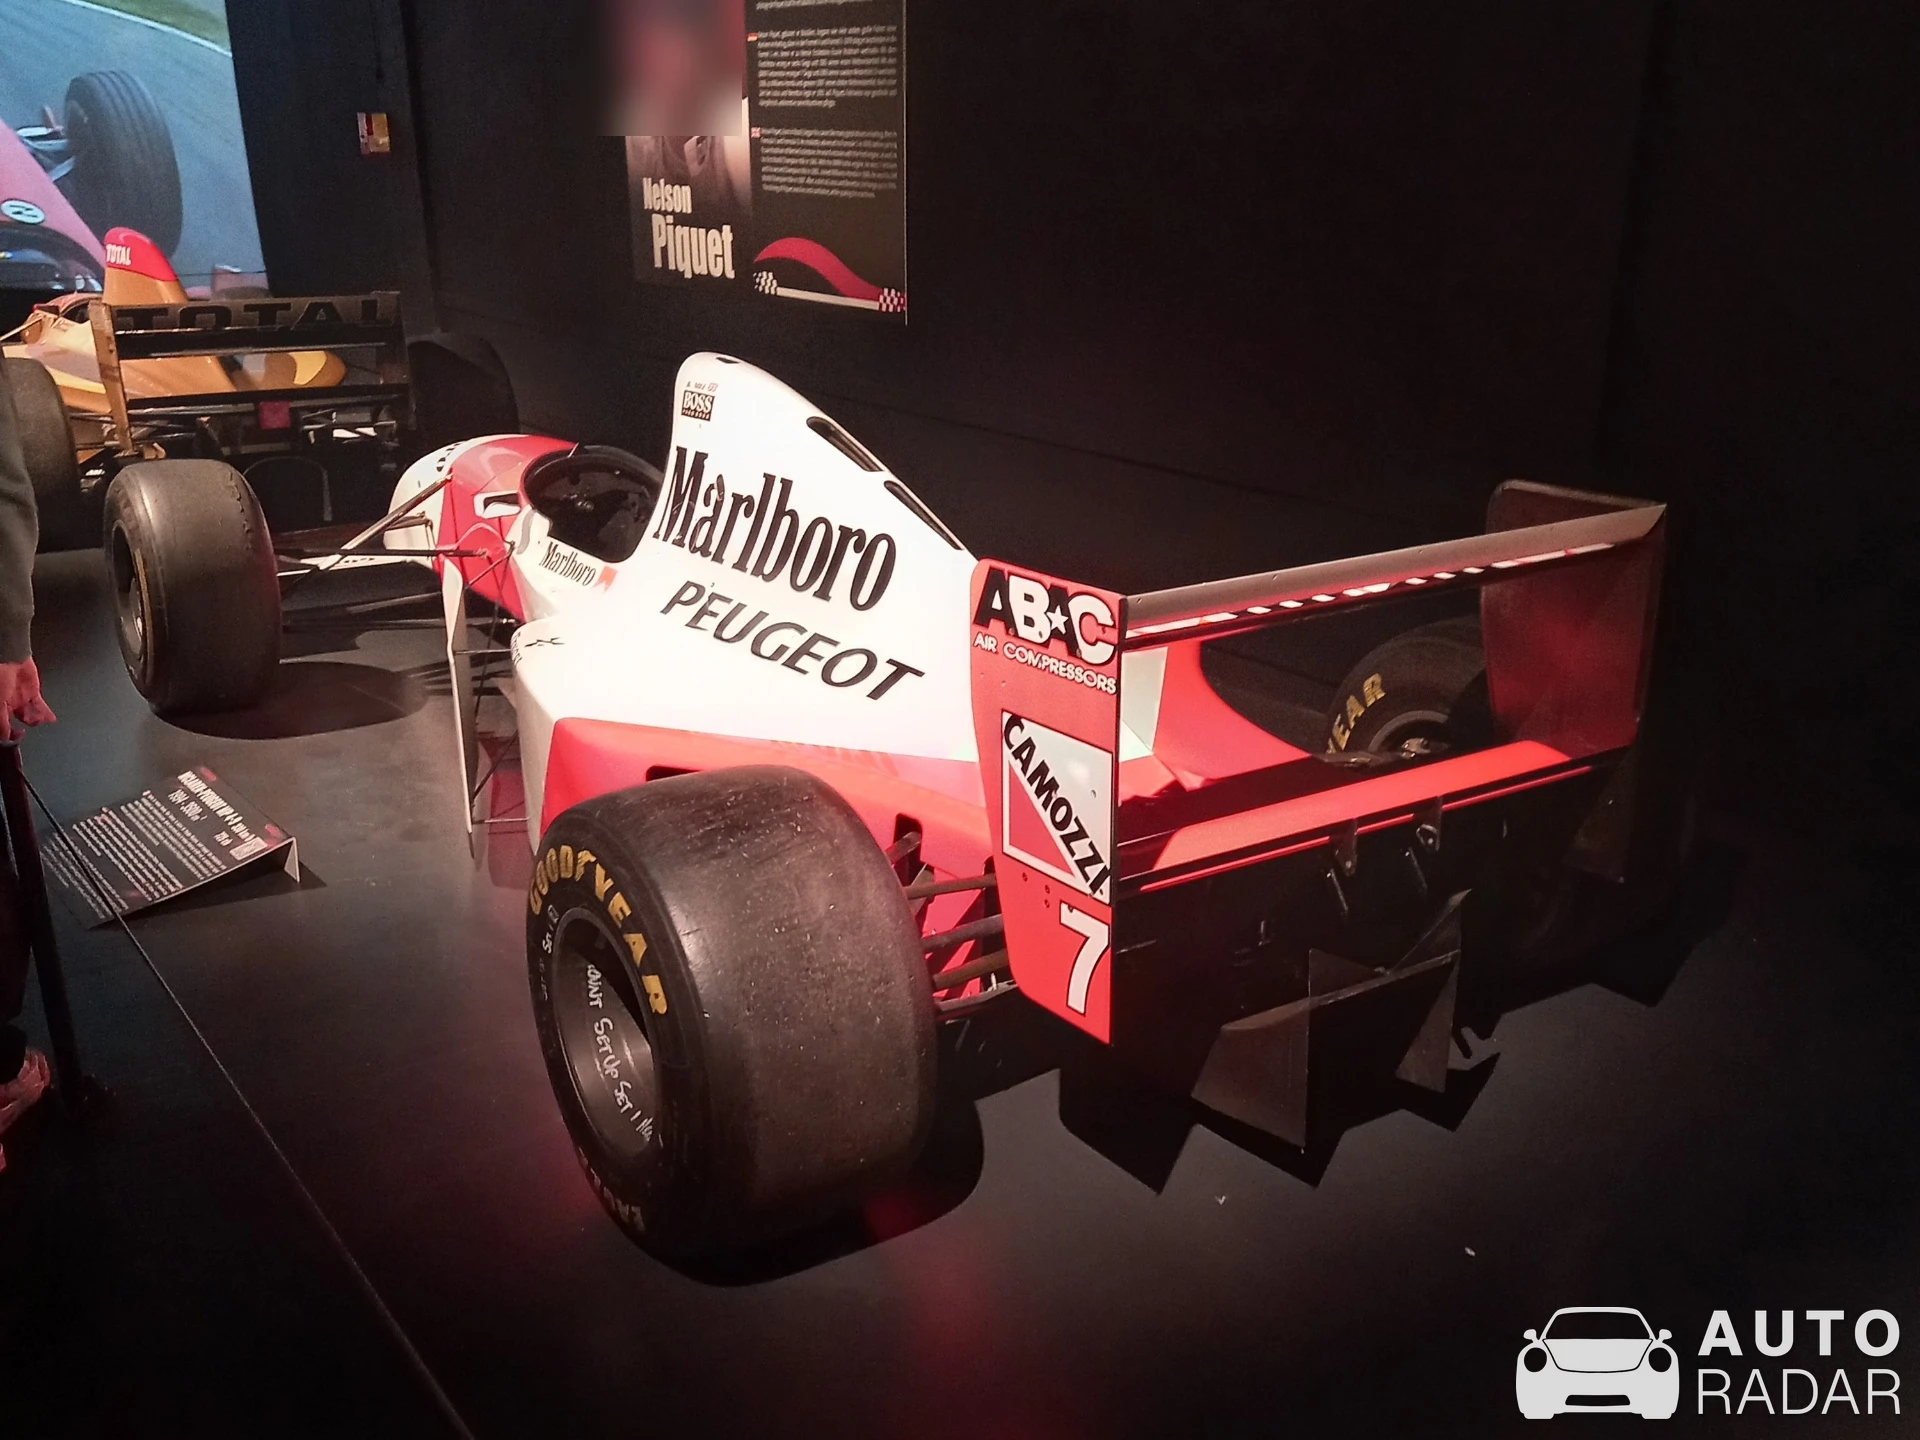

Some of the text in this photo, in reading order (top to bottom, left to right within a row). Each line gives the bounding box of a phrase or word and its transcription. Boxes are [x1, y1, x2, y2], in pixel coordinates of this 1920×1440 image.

[643, 177, 692, 214] Nelson
[106, 243, 132, 266] TOTAL
[652, 213, 735, 279] Piquet
[683, 391, 713, 414] BOSS
[652, 446, 897, 611] Marlboro
[539, 541, 597, 586] Marlboro
[660, 580, 926, 700] PEUGEOT
[973, 565, 1118, 665] ABAC
[974, 632, 1117, 695] AIR COMPRESSORS
[1003, 714, 1111, 896] CAMOZZI
[530, 845, 668, 1015] GOODYEAR
[1060, 900, 1111, 1017] 7
[614, 1080, 634, 1114] SET
